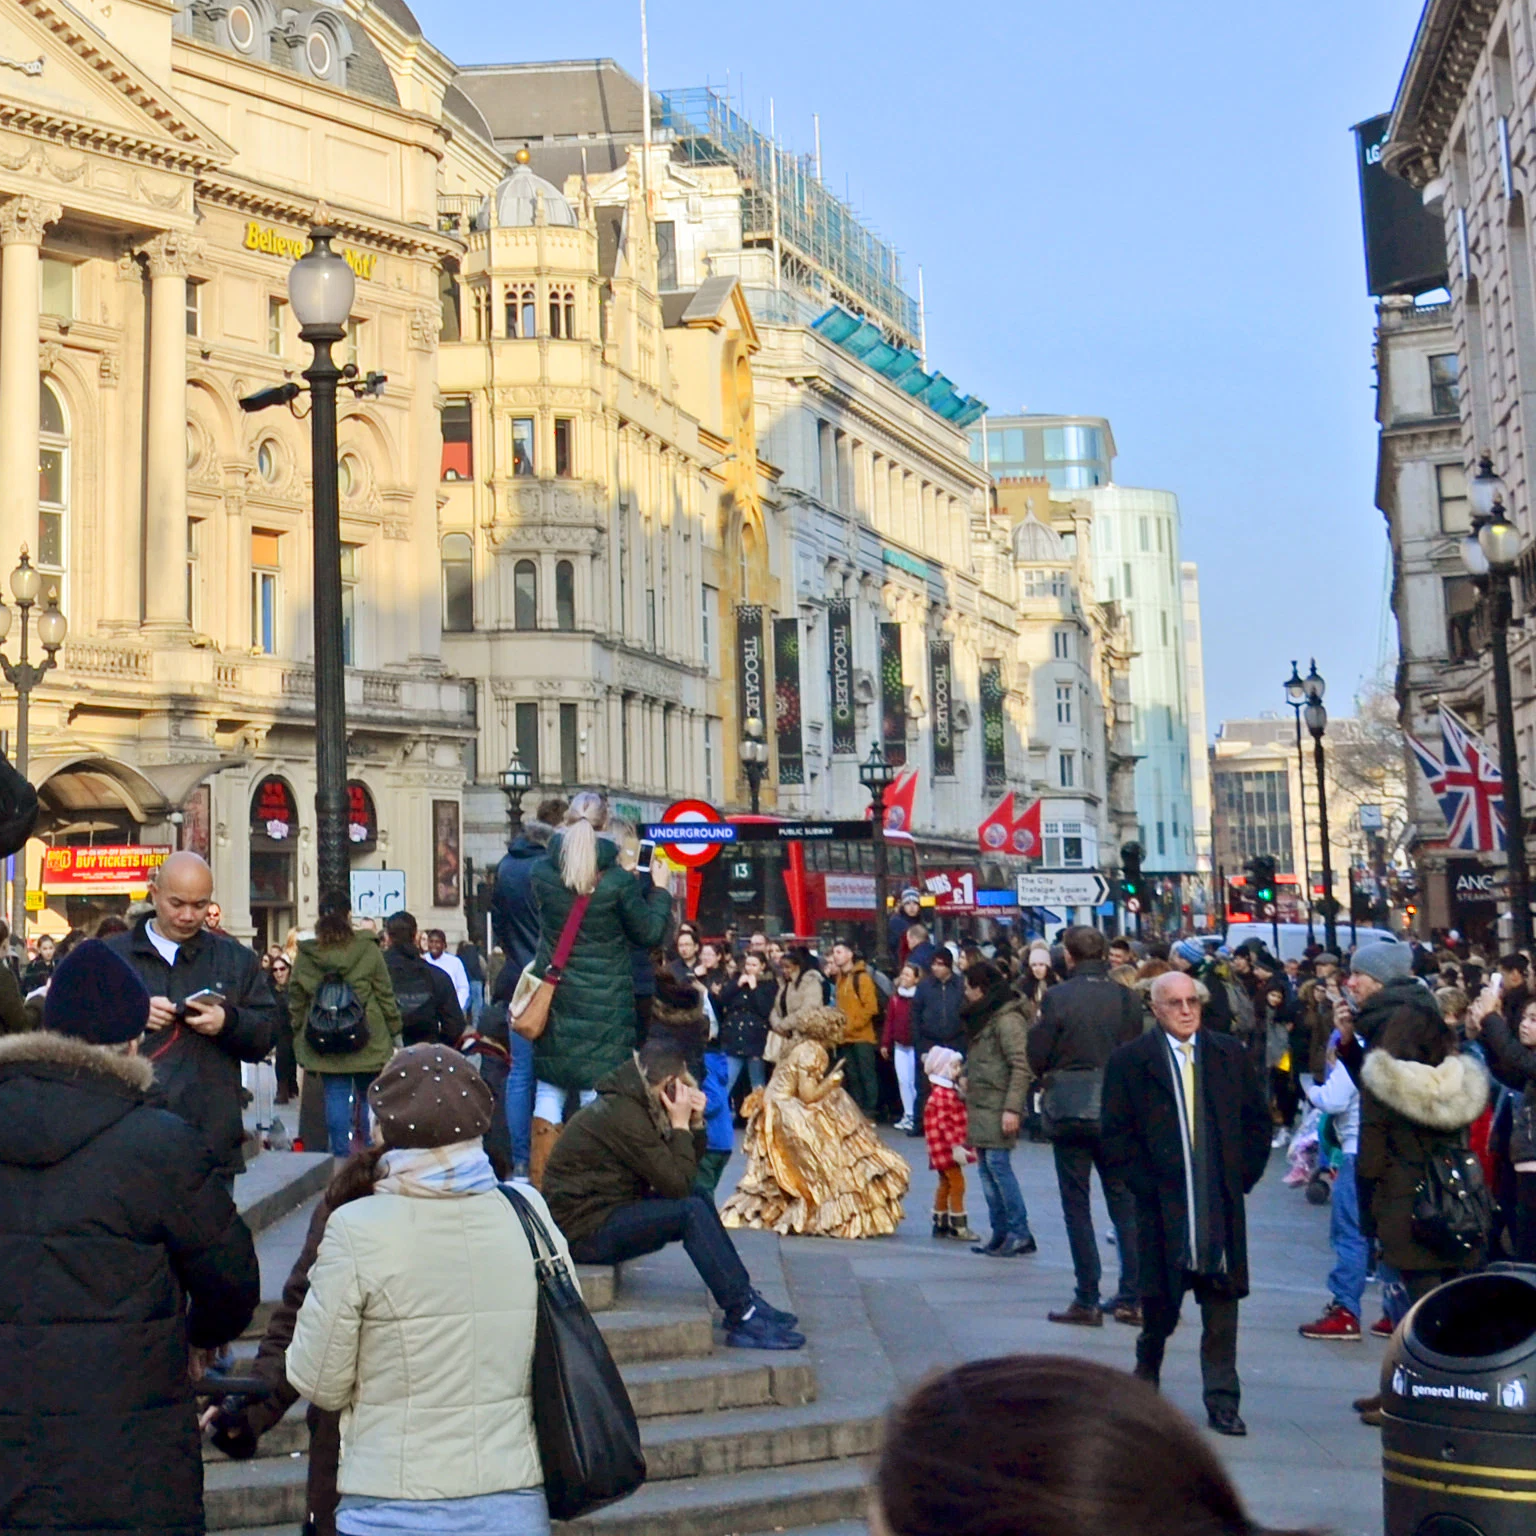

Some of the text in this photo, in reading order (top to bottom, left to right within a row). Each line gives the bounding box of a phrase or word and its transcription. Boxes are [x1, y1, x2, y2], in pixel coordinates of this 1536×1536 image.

[1366, 144, 1381, 164] LG
[246, 221, 304, 261] Believe
[834, 625, 849, 720] TROCADERO
[935, 664, 949, 745] TROCADERO
[649, 827, 734, 839] UNDERGROUND
[76, 855, 96, 868] BUY
[99, 854, 140, 867] TICKETS
[734, 863, 748, 878] 13
[953, 873, 975, 904] £1
[1037, 877, 1054, 885] City
[1412, 1385, 1489, 1402] general litter
